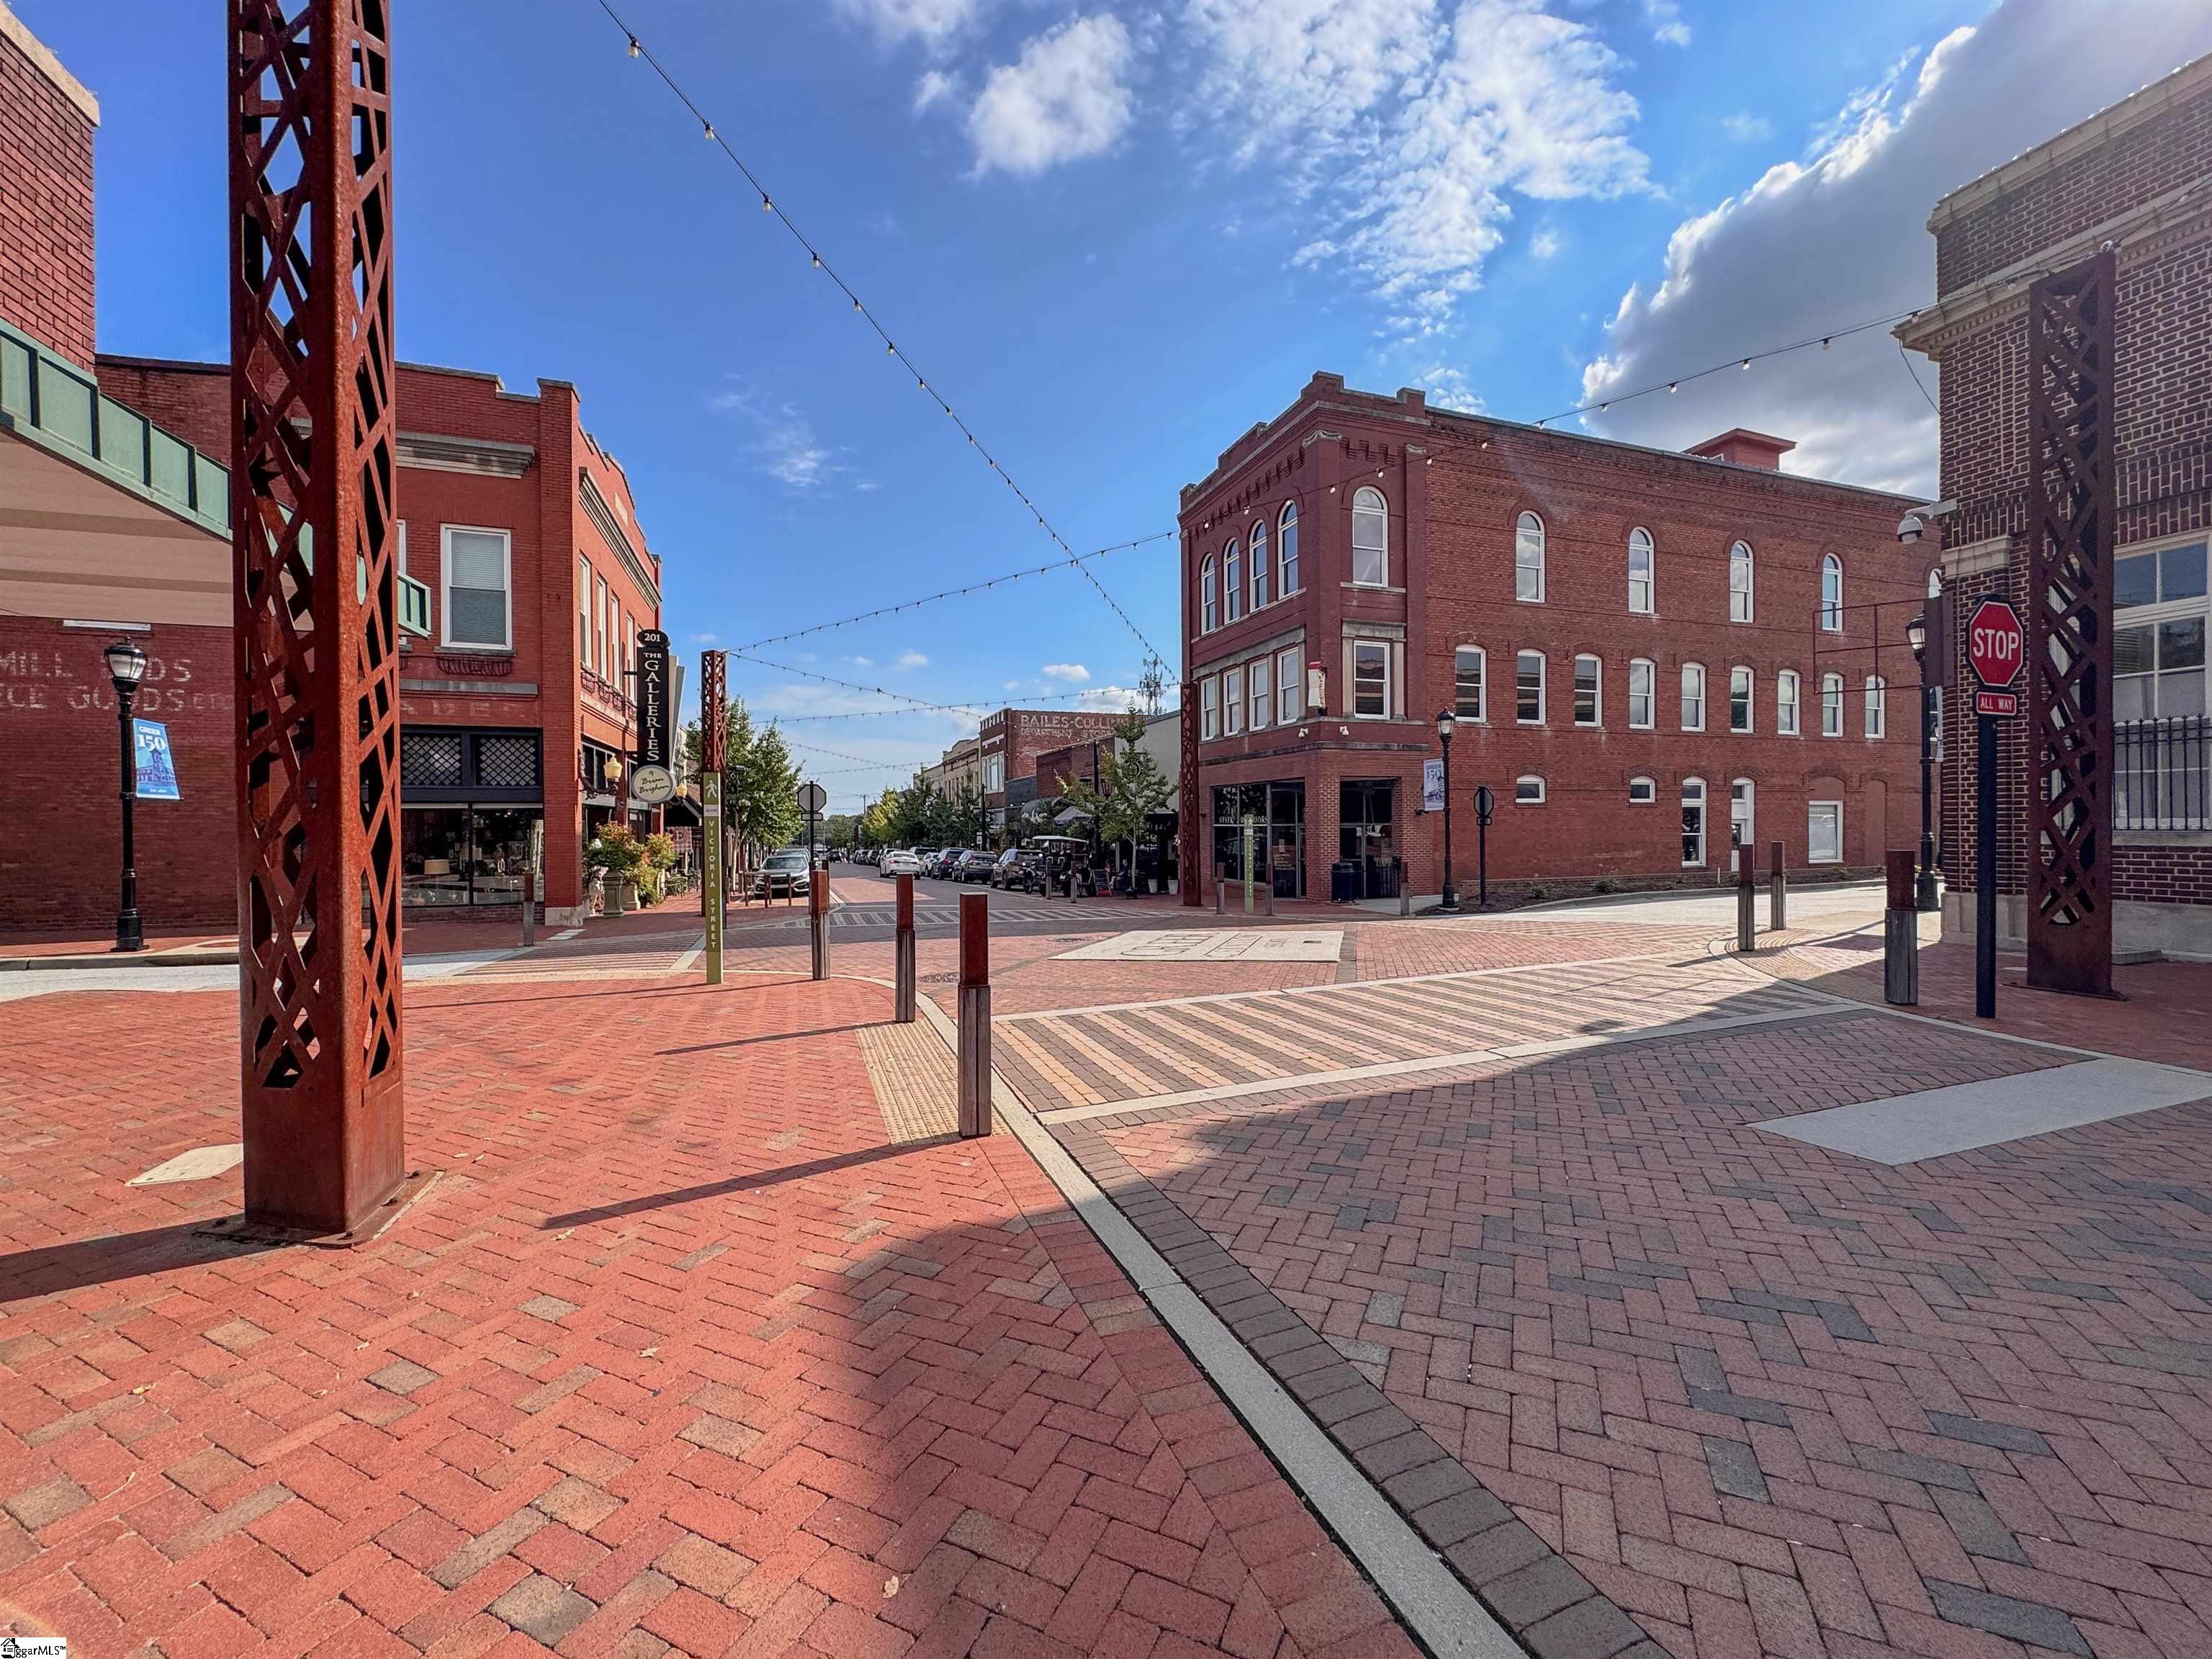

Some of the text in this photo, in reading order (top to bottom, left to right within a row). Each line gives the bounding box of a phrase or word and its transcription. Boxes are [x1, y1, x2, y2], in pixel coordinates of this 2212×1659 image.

[1973, 628, 2019, 660] STOP
[644, 660, 661, 761] GALLERIES
[1980, 697, 2013, 711] ALL WAY
[1020, 729, 1073, 737] DEPARTMENT
[138, 734, 166, 751] 150
[1426, 770, 1441, 780] 150
